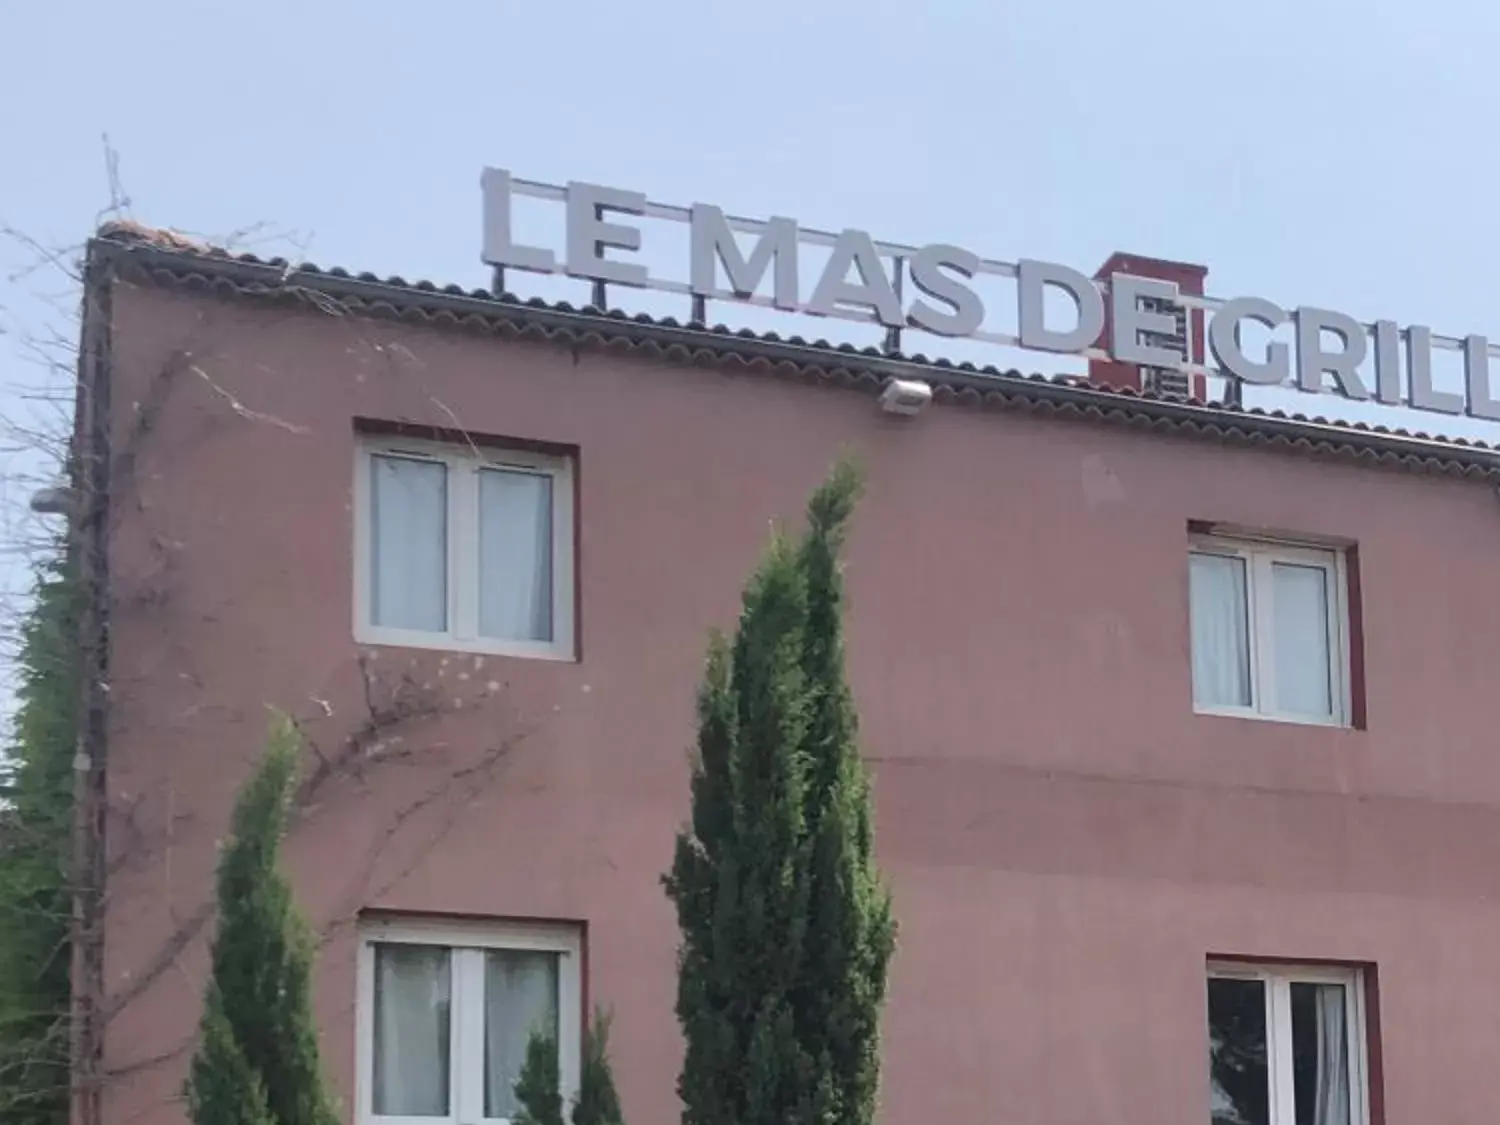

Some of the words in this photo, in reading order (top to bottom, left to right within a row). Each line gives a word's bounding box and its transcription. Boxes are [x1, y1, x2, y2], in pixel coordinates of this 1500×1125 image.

[480, 167, 648, 287] LE
[690, 201, 985, 337] MAS
[1017, 258, 1181, 367] DE
